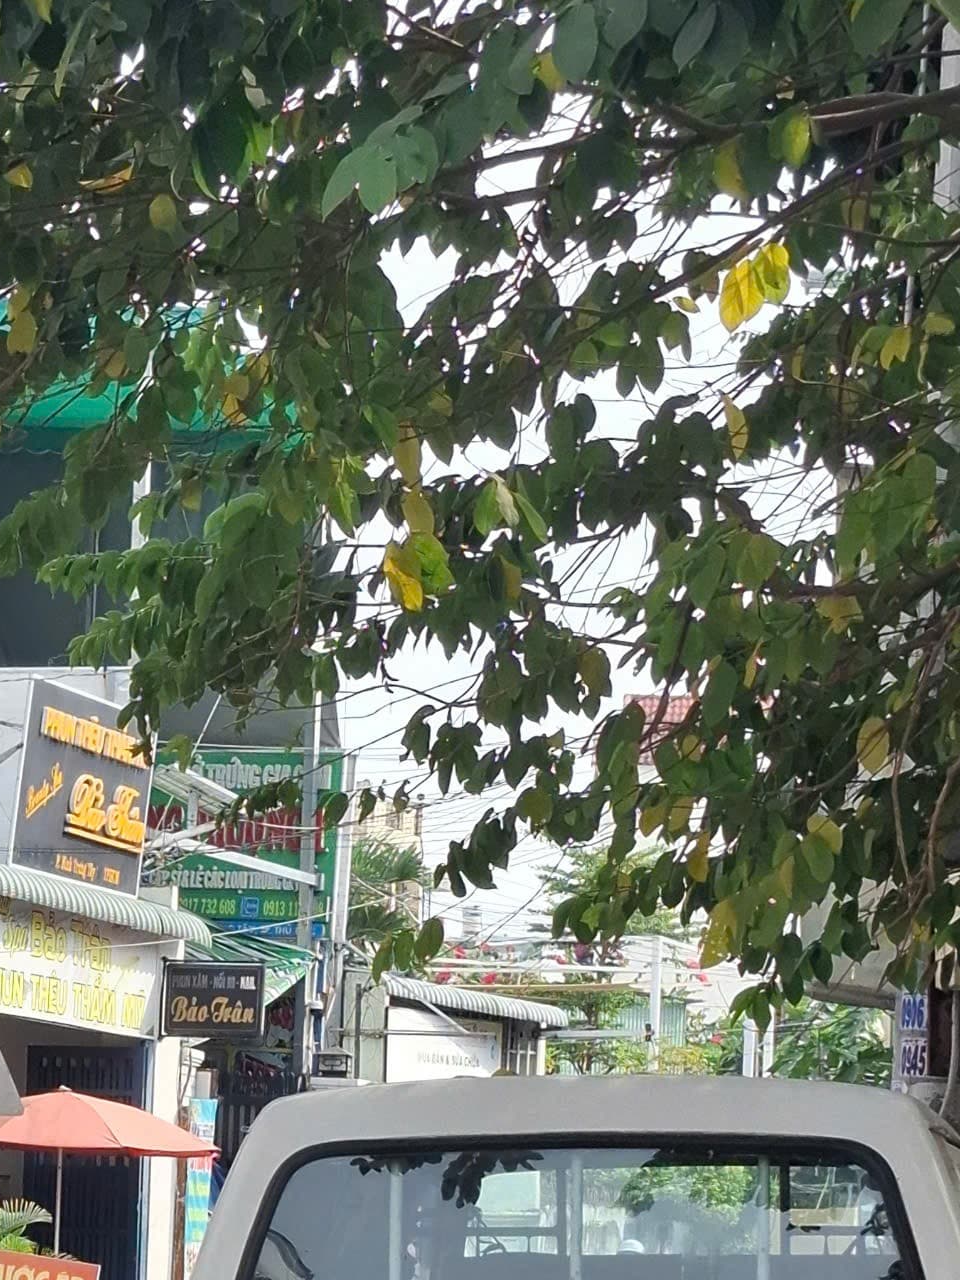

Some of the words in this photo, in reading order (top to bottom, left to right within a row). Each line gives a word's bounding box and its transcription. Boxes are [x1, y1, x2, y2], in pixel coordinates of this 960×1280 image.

[201, 898, 218, 915] 732
[219, 899, 235, 916] 608
[263, 901, 286, 916] 0913
[30, 970, 68, 1017] THÊU
[171, 996, 210, 1023] Bảo
[211, 996, 255, 1024] Trân
